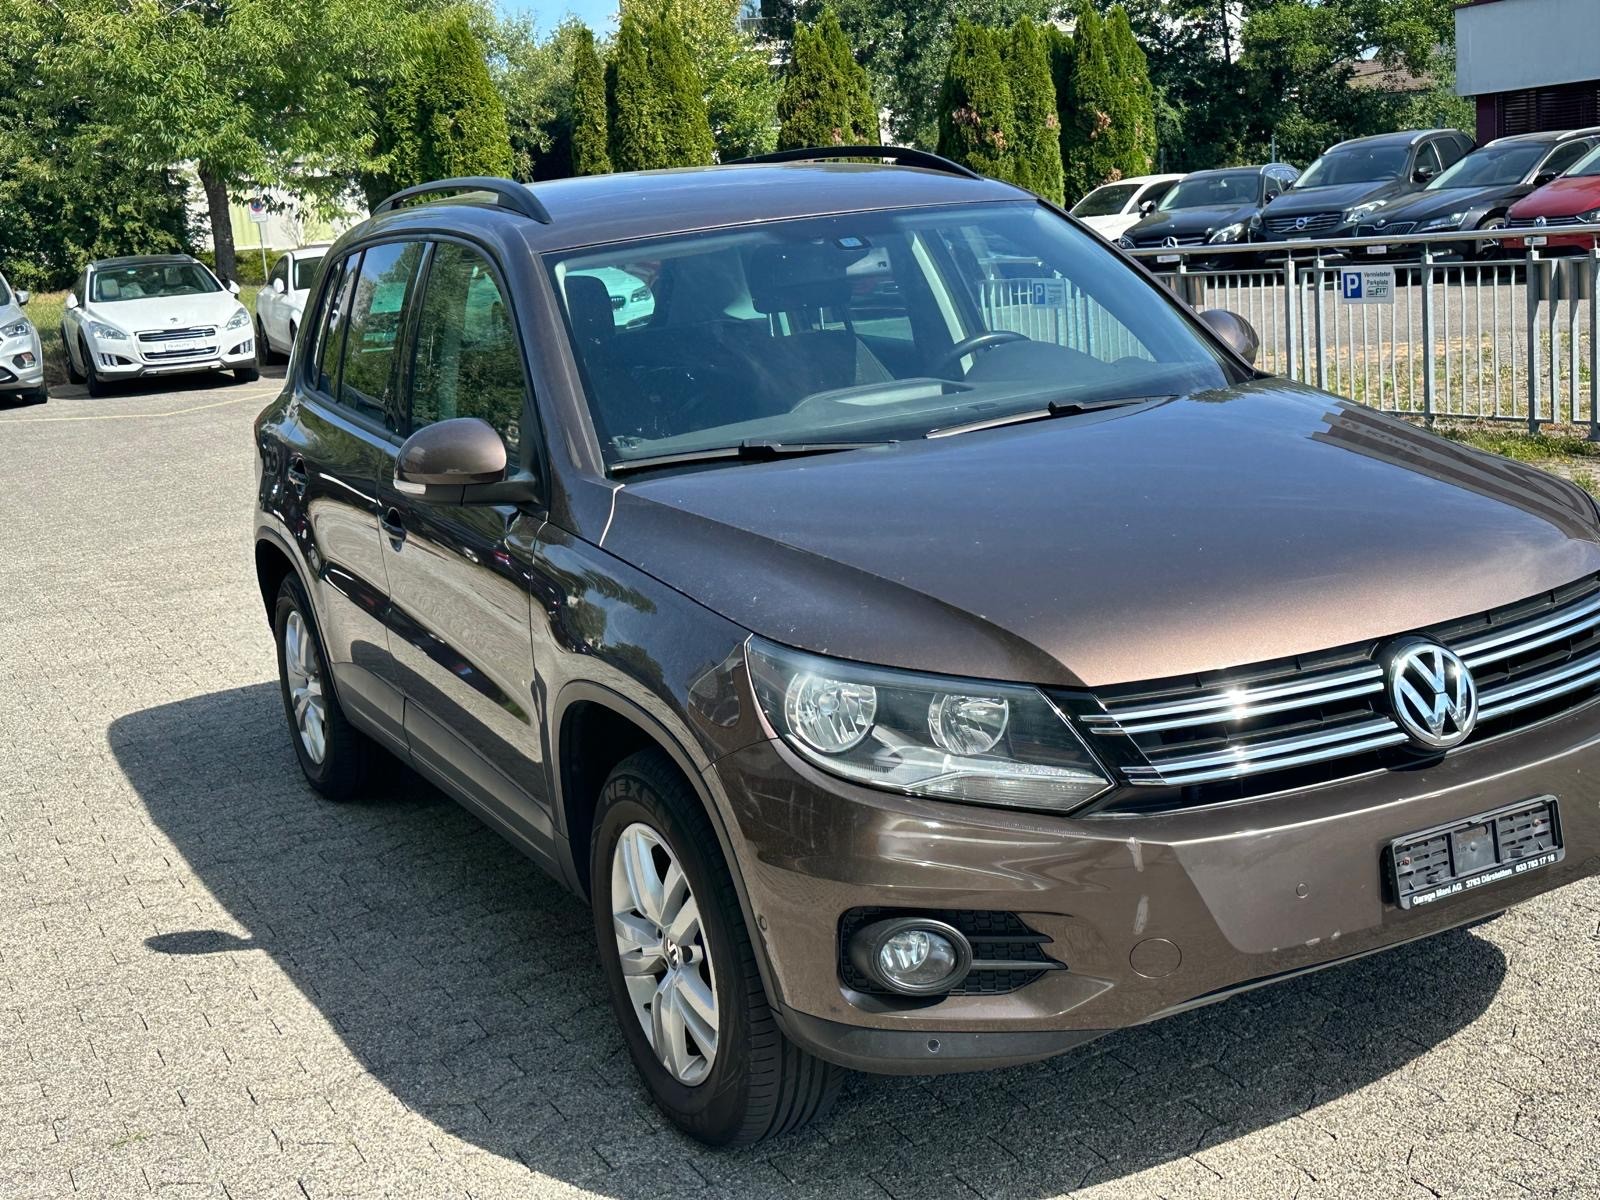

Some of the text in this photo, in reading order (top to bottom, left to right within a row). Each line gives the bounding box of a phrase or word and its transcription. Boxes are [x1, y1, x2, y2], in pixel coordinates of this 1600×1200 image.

[1346, 274, 1359, 297] P
[1394, 646, 1473, 743] VW
[1412, 891, 1436, 904] Garage
[1452, 882, 1462, 893] AG
[1539, 856, 1547, 866] 17
